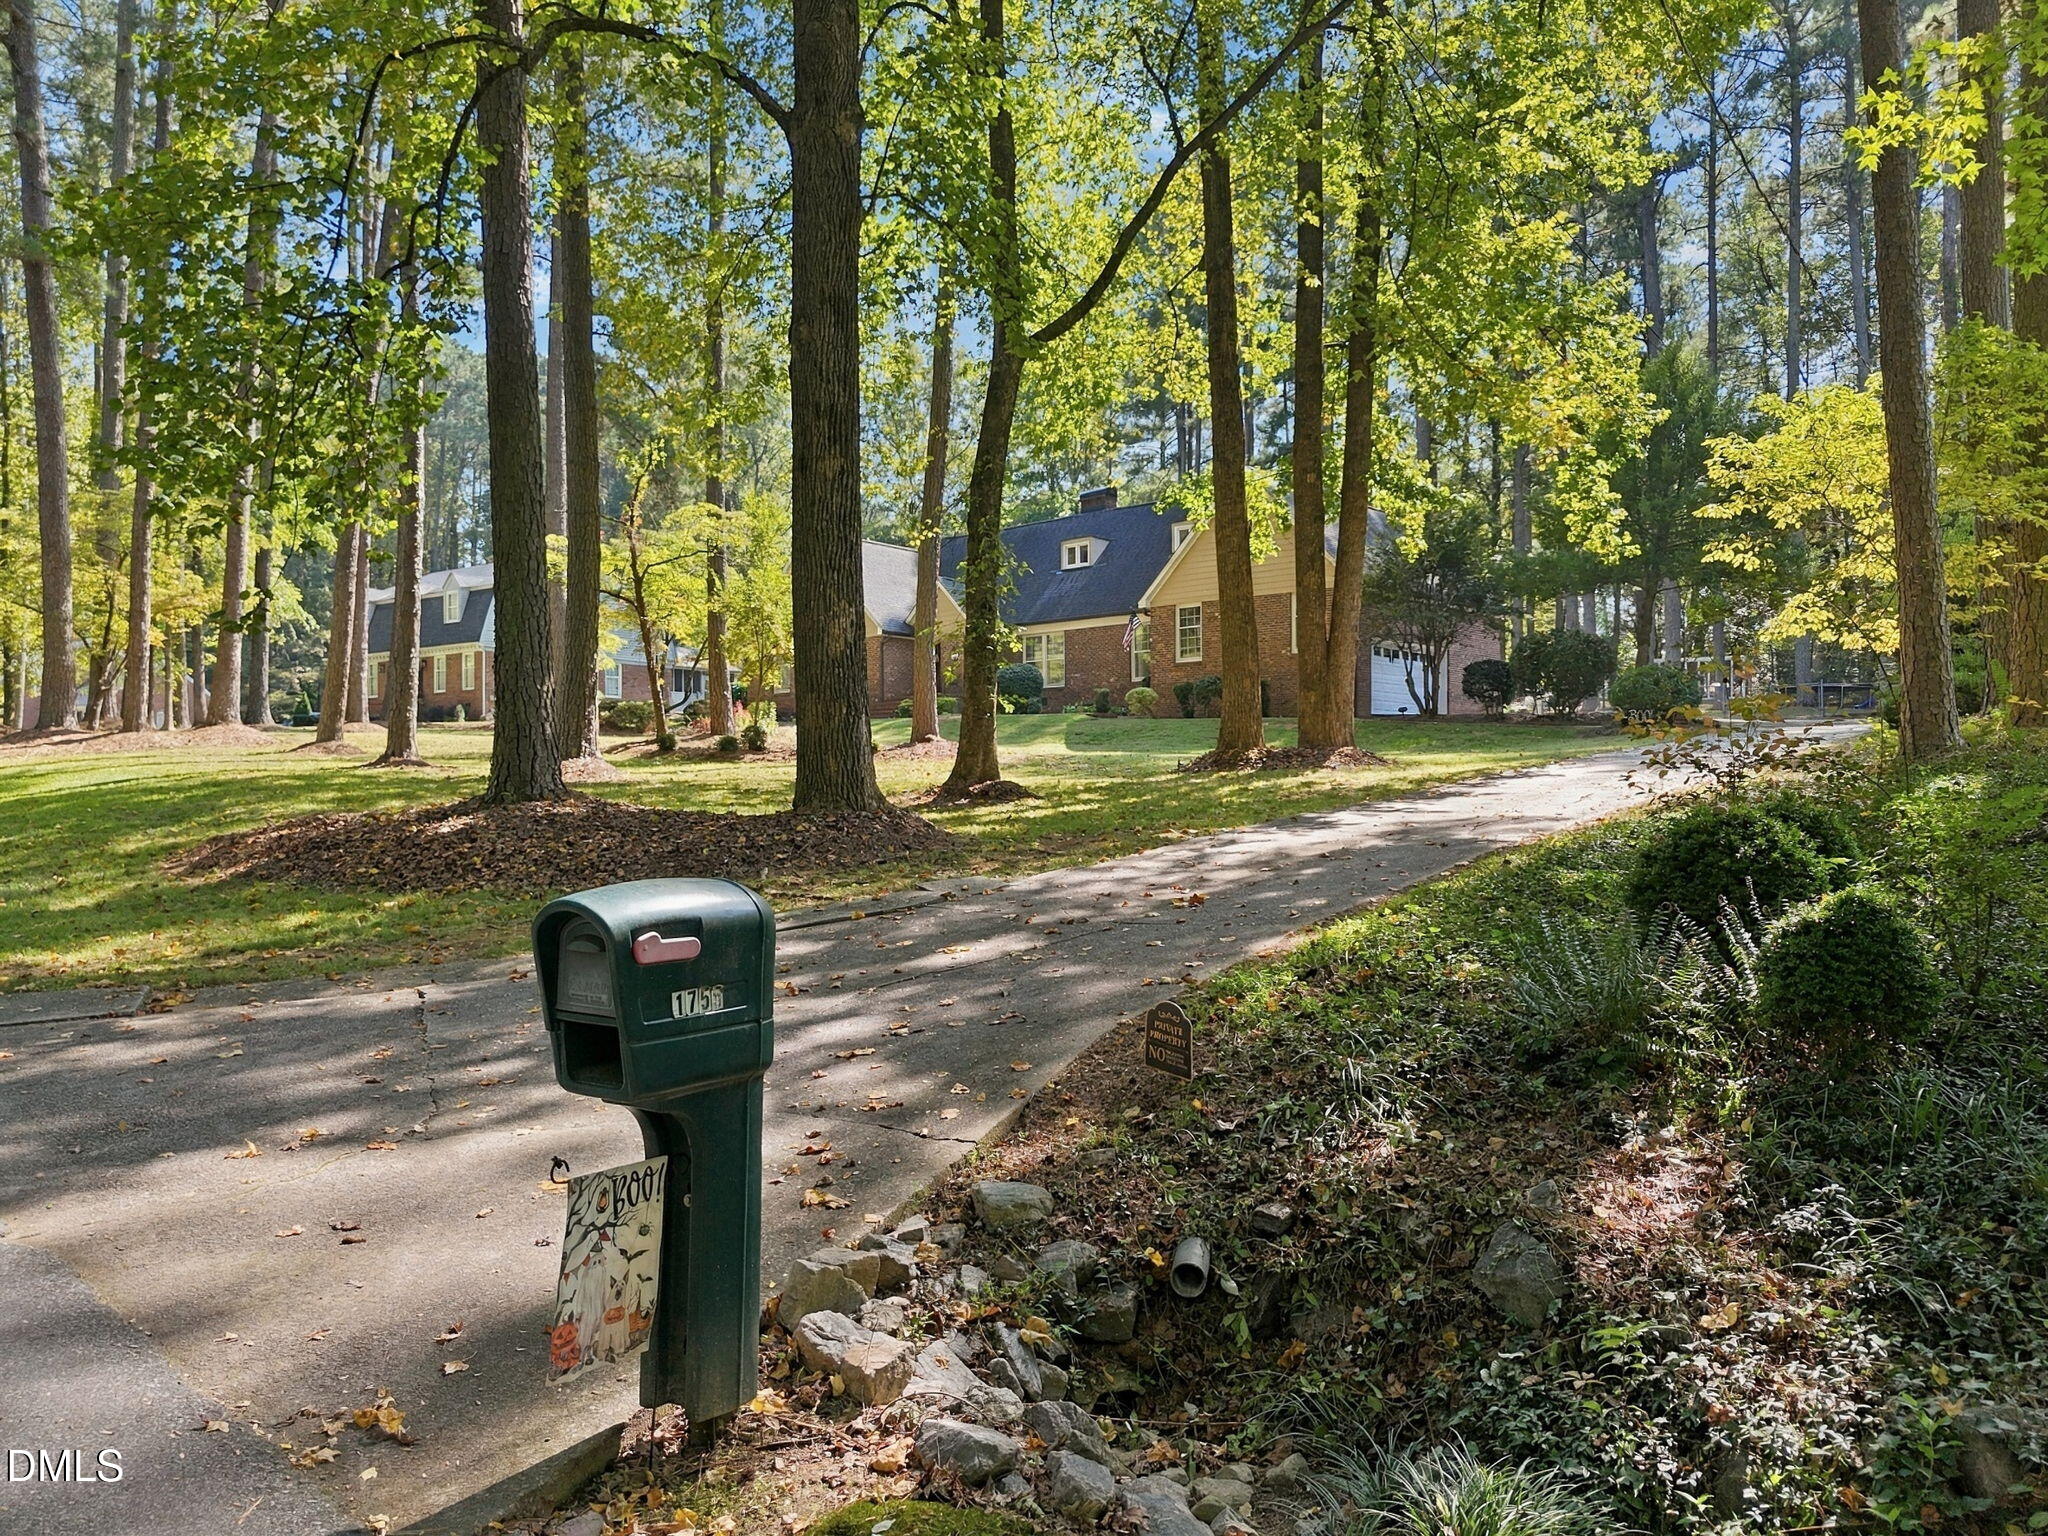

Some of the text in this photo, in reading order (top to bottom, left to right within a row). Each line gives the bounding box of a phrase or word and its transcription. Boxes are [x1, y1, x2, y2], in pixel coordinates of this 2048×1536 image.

[1154, 1020, 1183, 1036] PRIVATE
[1149, 1030, 1188, 1048] PROPERTY
[1148, 1044, 1166, 1062] NO
[611, 1162, 665, 1220] BOO!
